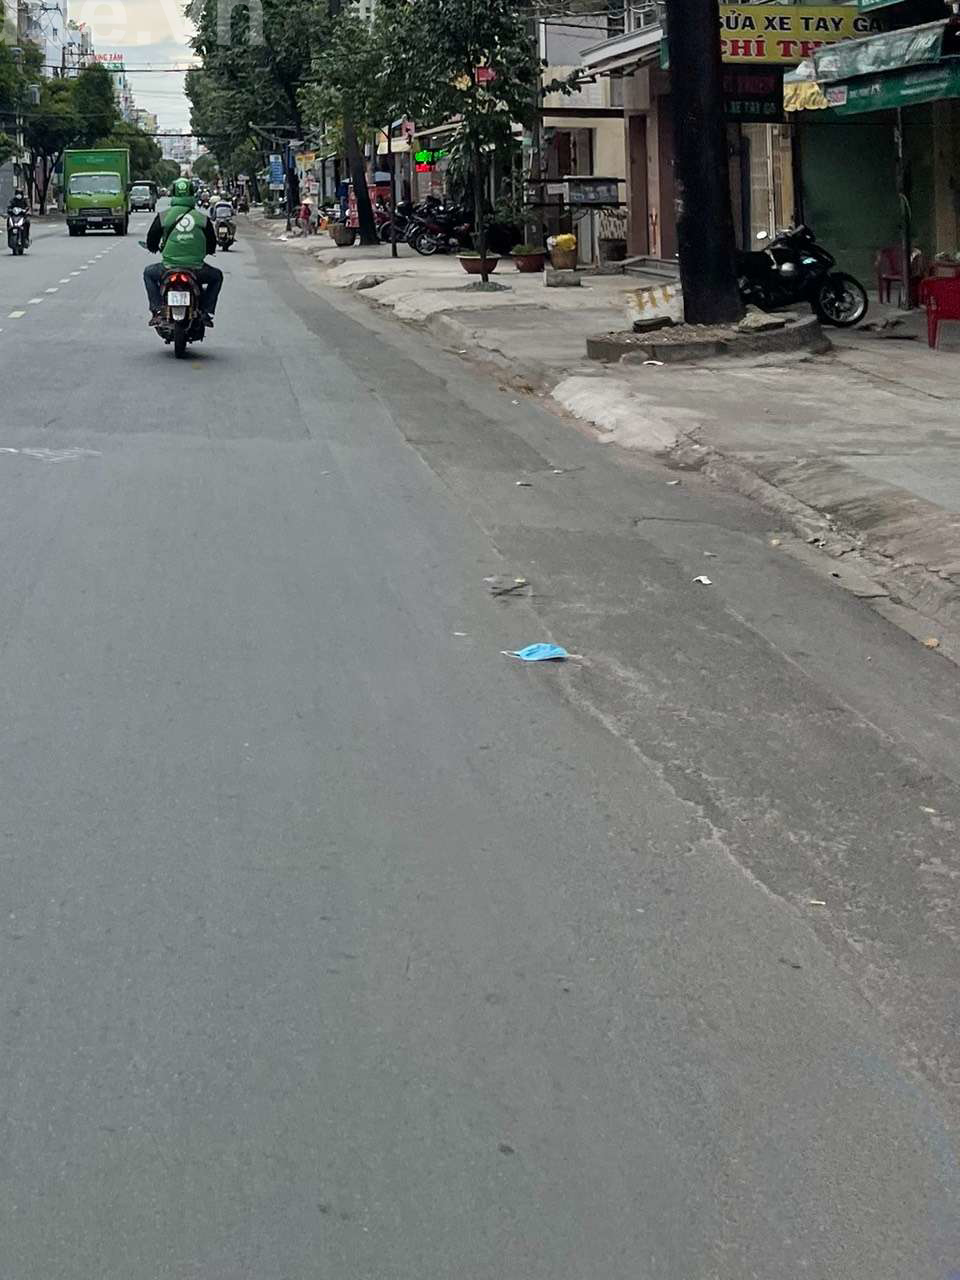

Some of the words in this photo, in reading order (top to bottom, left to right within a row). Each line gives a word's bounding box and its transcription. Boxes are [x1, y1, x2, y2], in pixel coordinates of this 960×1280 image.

[764, 15, 792, 32] XE
[800, 16, 844, 32] TAY
[852, 17, 882, 33] GA
